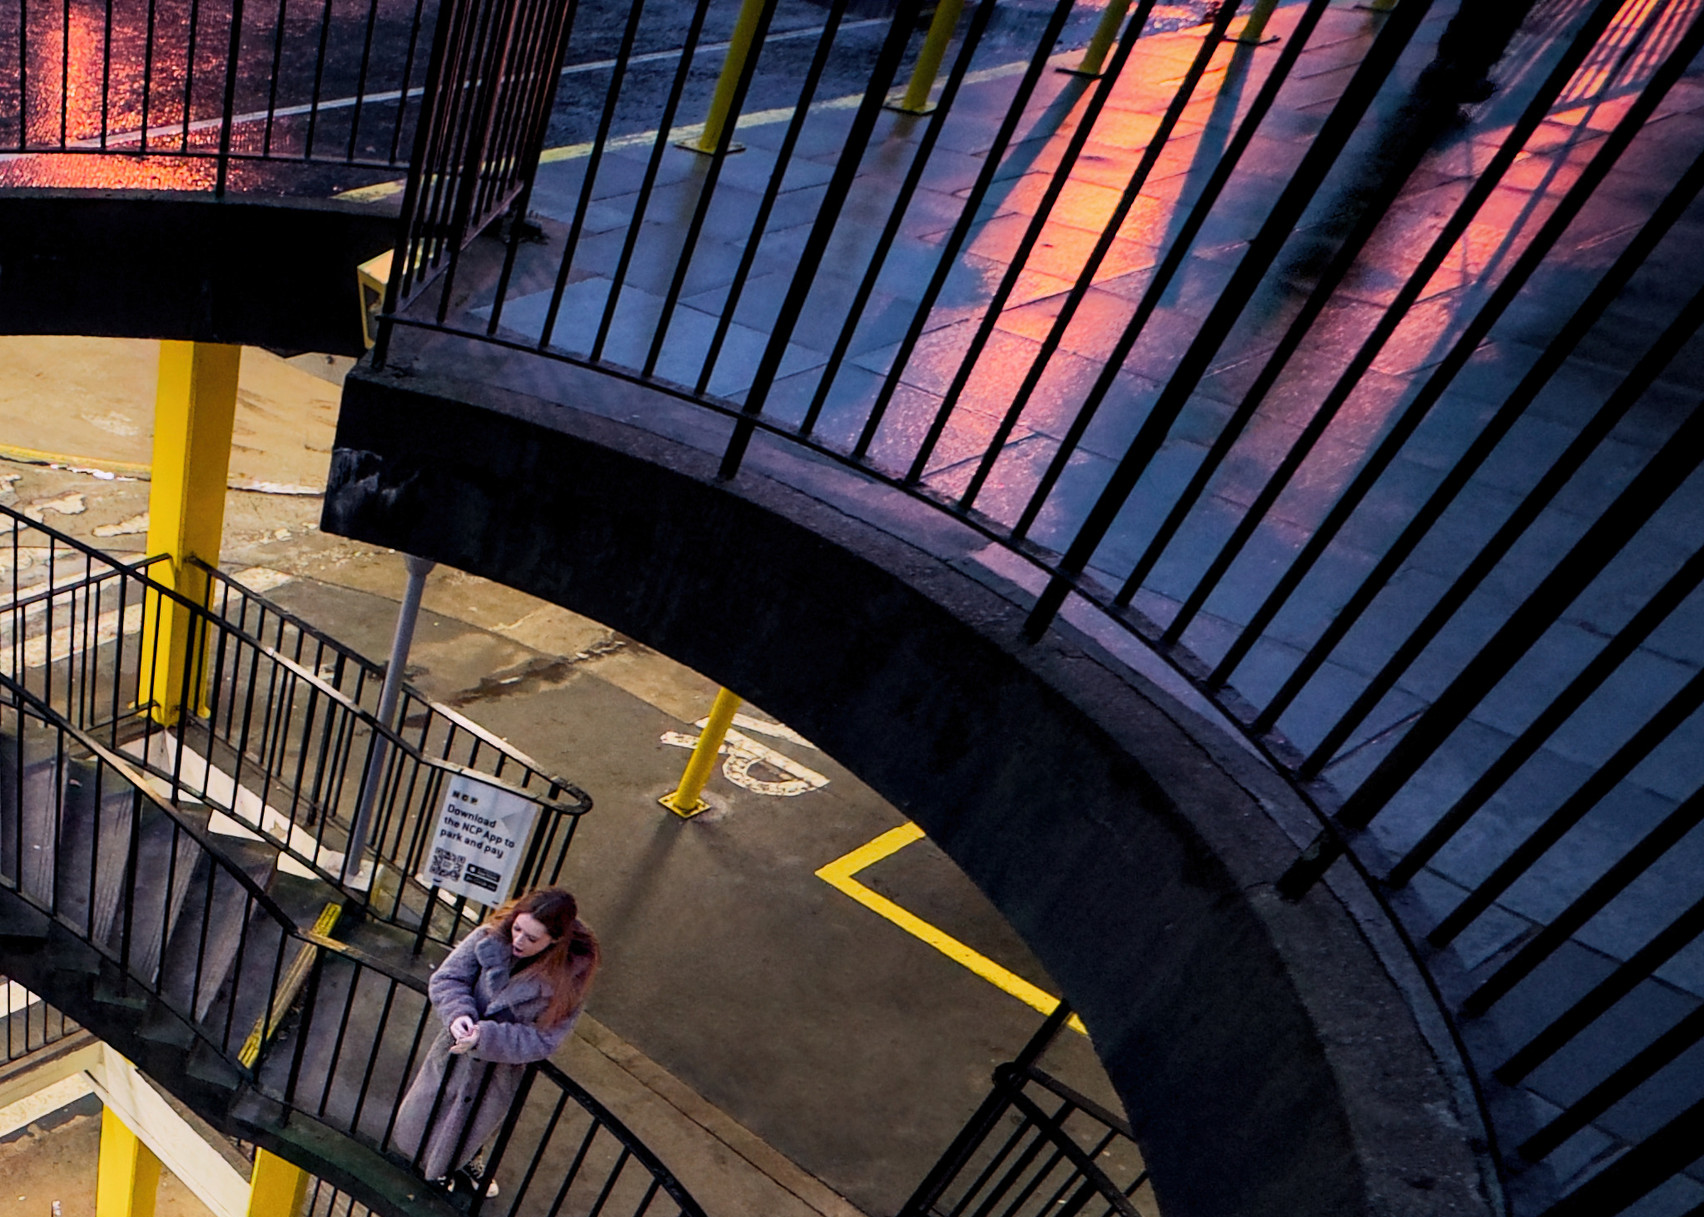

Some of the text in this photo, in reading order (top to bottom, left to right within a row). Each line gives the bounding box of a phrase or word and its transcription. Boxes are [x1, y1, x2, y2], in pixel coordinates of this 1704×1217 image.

[452, 790, 478, 805] NCP
[447, 804, 497, 828] Download
[440, 829, 504, 859] park and pay
[444, 817, 515, 848] the NCP App to
